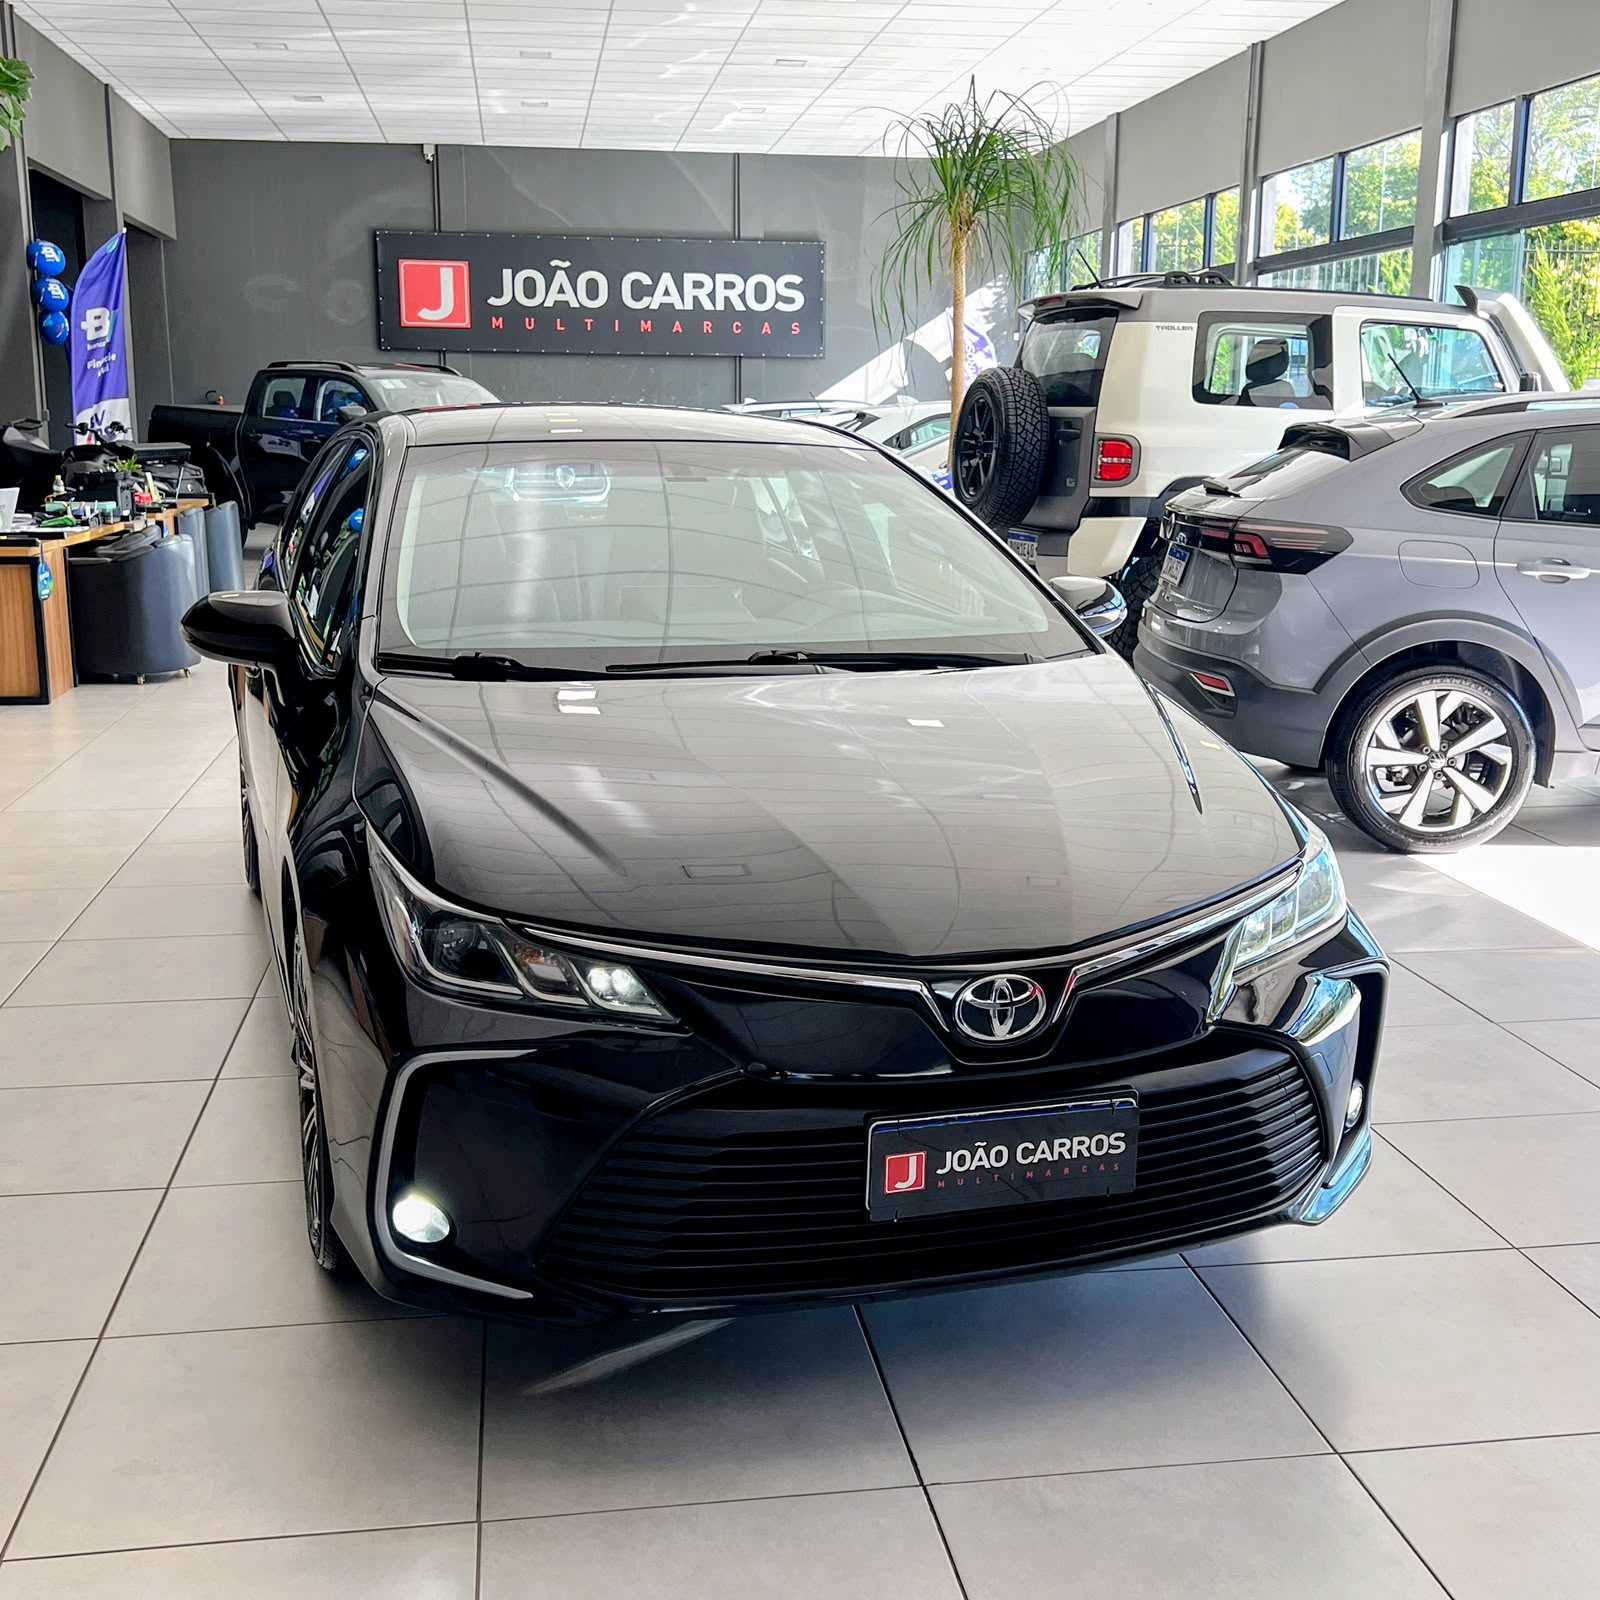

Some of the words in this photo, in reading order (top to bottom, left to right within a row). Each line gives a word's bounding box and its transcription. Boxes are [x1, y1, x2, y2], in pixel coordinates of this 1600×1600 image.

[416, 266, 453, 322] J
[486, 259, 609, 309] JOÃO
[621, 271, 805, 313] CARROS
[492, 316, 800, 335] MULTIMARCAS
[935, 1141, 1009, 1175] JOÃO
[1016, 1132, 1126, 1165] CARROS
[937, 1162, 1120, 1189] MULTIMARCAS
